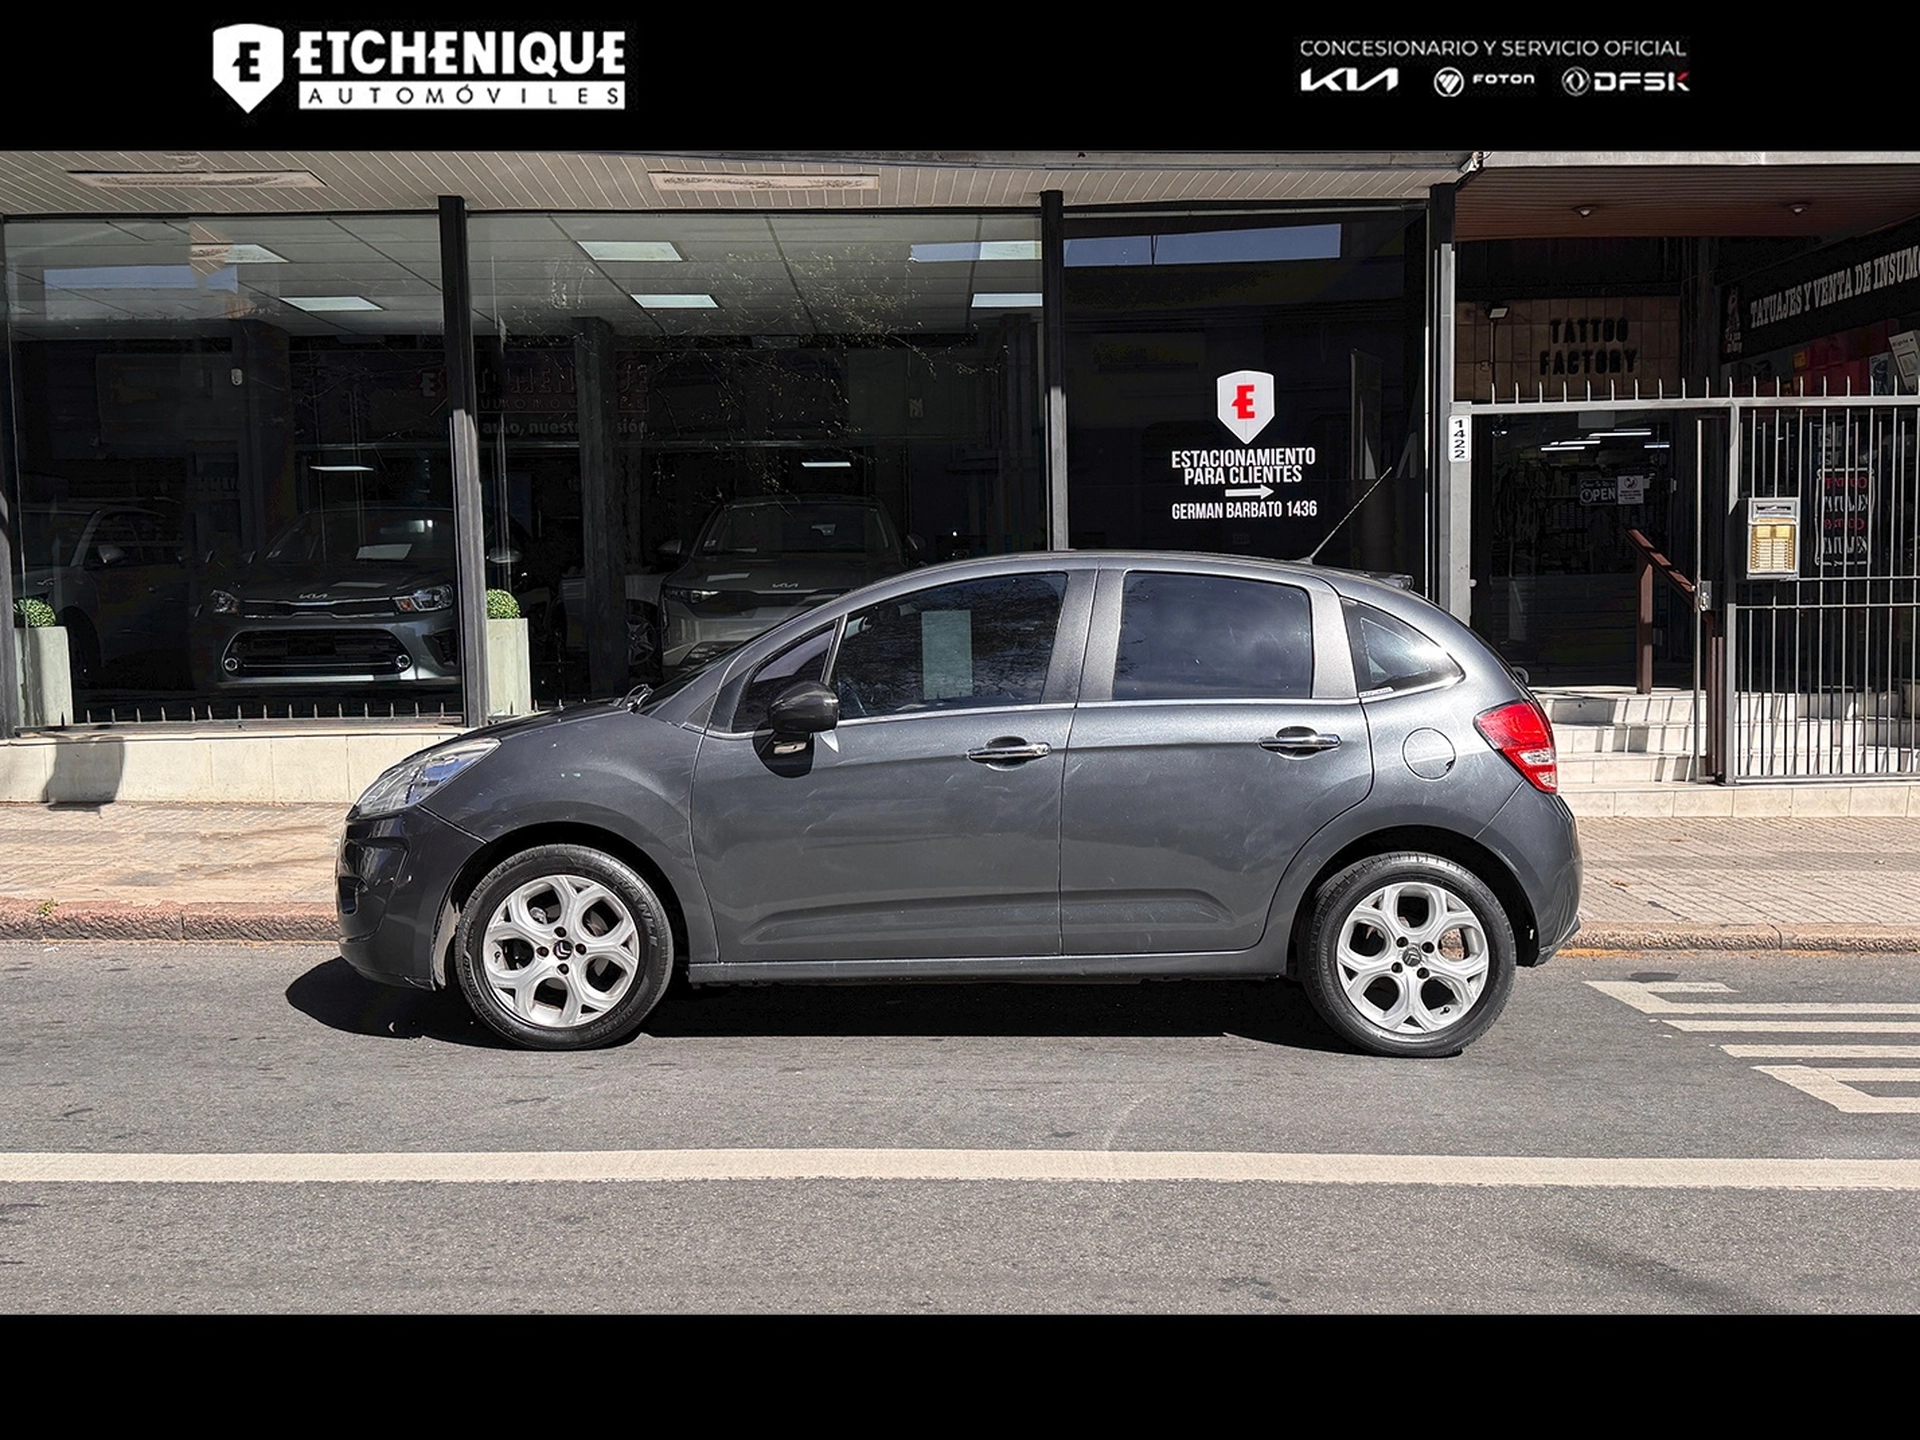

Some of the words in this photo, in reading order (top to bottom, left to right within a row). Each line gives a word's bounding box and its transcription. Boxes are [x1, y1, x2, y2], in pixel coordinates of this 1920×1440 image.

[1751, 285, 1802, 328] TATUAJES
[1804, 281, 1812, 312] Y
[1813, 267, 1852, 308] VENTA
[1855, 261, 1871, 297] DE
[1873, 245, 1920, 290] INSUM
[1550, 317, 1629, 344] TATTOO
[1539, 348, 1637, 376] FACTORY
[1231, 384, 1256, 419] E
[1453, 419, 1466, 459] 1422
[1172, 447, 1316, 468] ESTACIONAMIENTO
[1184, 467, 1226, 486] PARA
[1229, 465, 1303, 484] CLIENTES
[1580, 487, 1616, 504] OPEN
[1172, 503, 1224, 520] GERMAN
[1226, 501, 1283, 519] BARBATO
[1287, 500, 1318, 517] 1436
